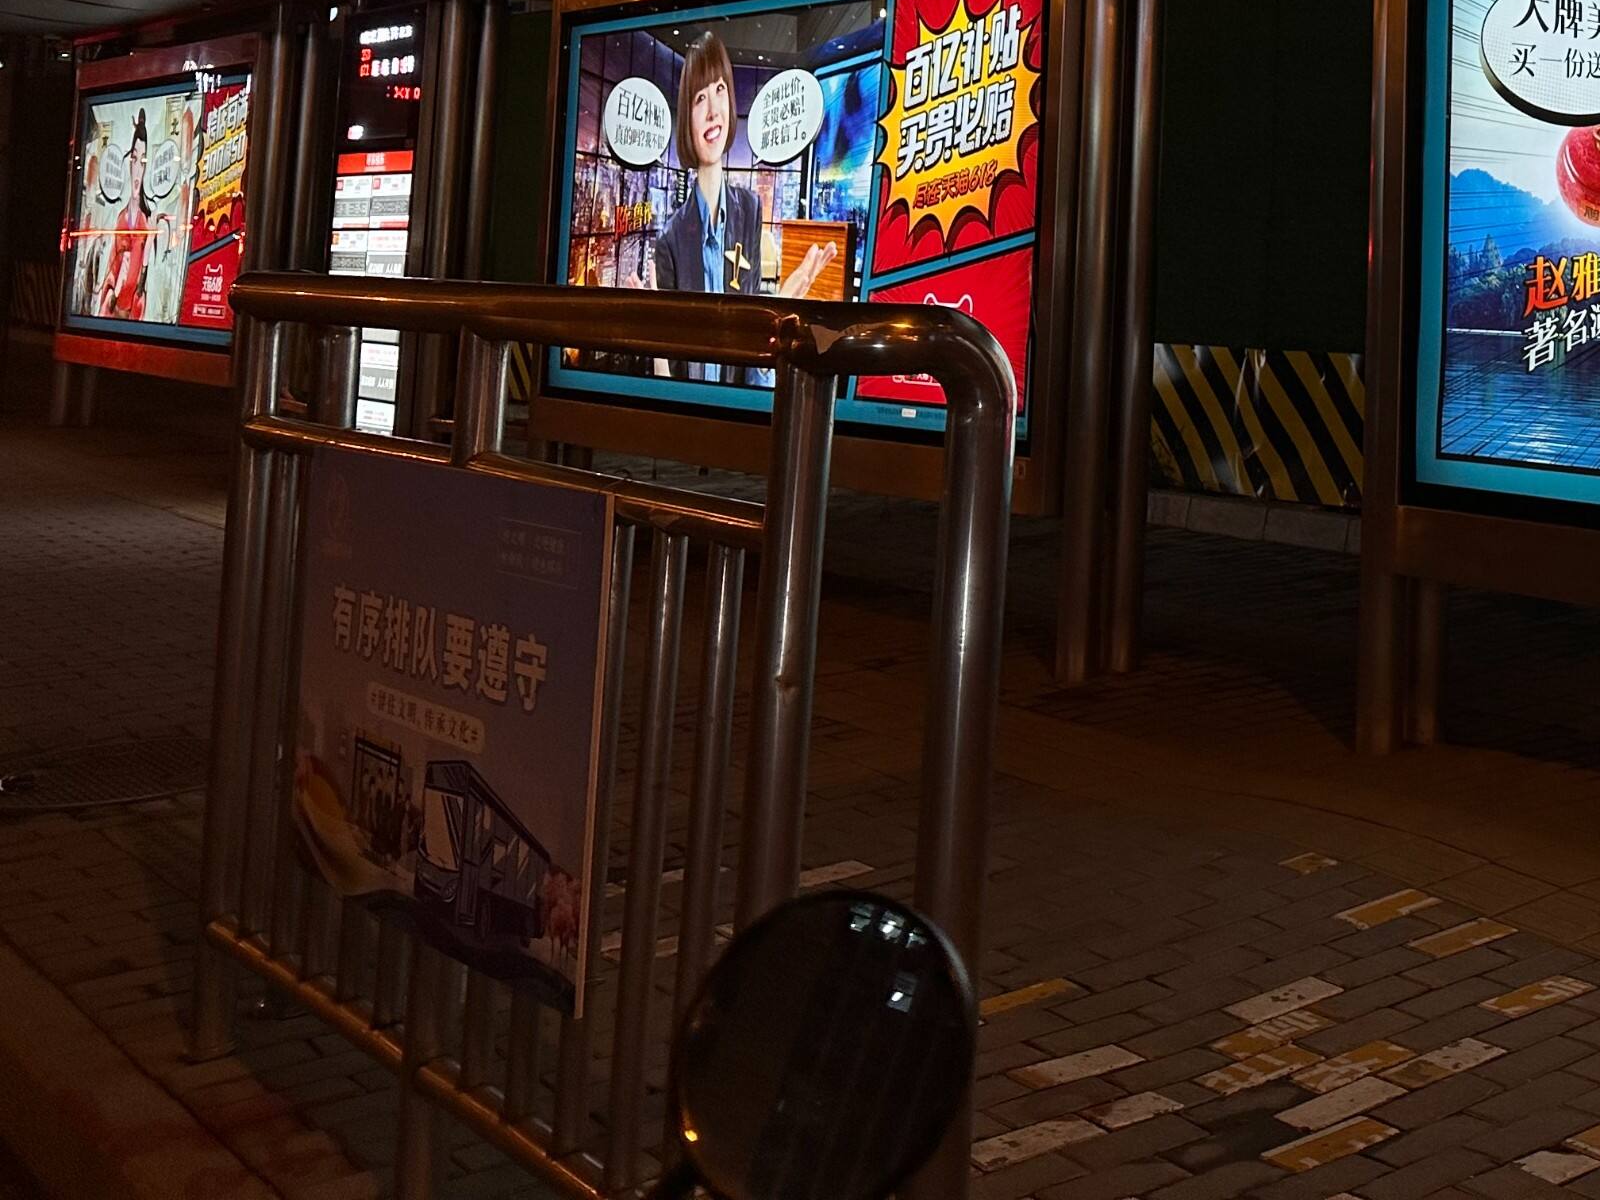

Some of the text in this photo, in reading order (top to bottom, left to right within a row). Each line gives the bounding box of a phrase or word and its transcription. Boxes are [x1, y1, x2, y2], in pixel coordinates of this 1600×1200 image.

[904, 3, 1021, 110] 百亿补贴
[896, 75, 1016, 181] 买贵必赔
[913, 160, 998, 209] 尽在天猫618
[332, 582, 548, 712] 有序排队要遵守
